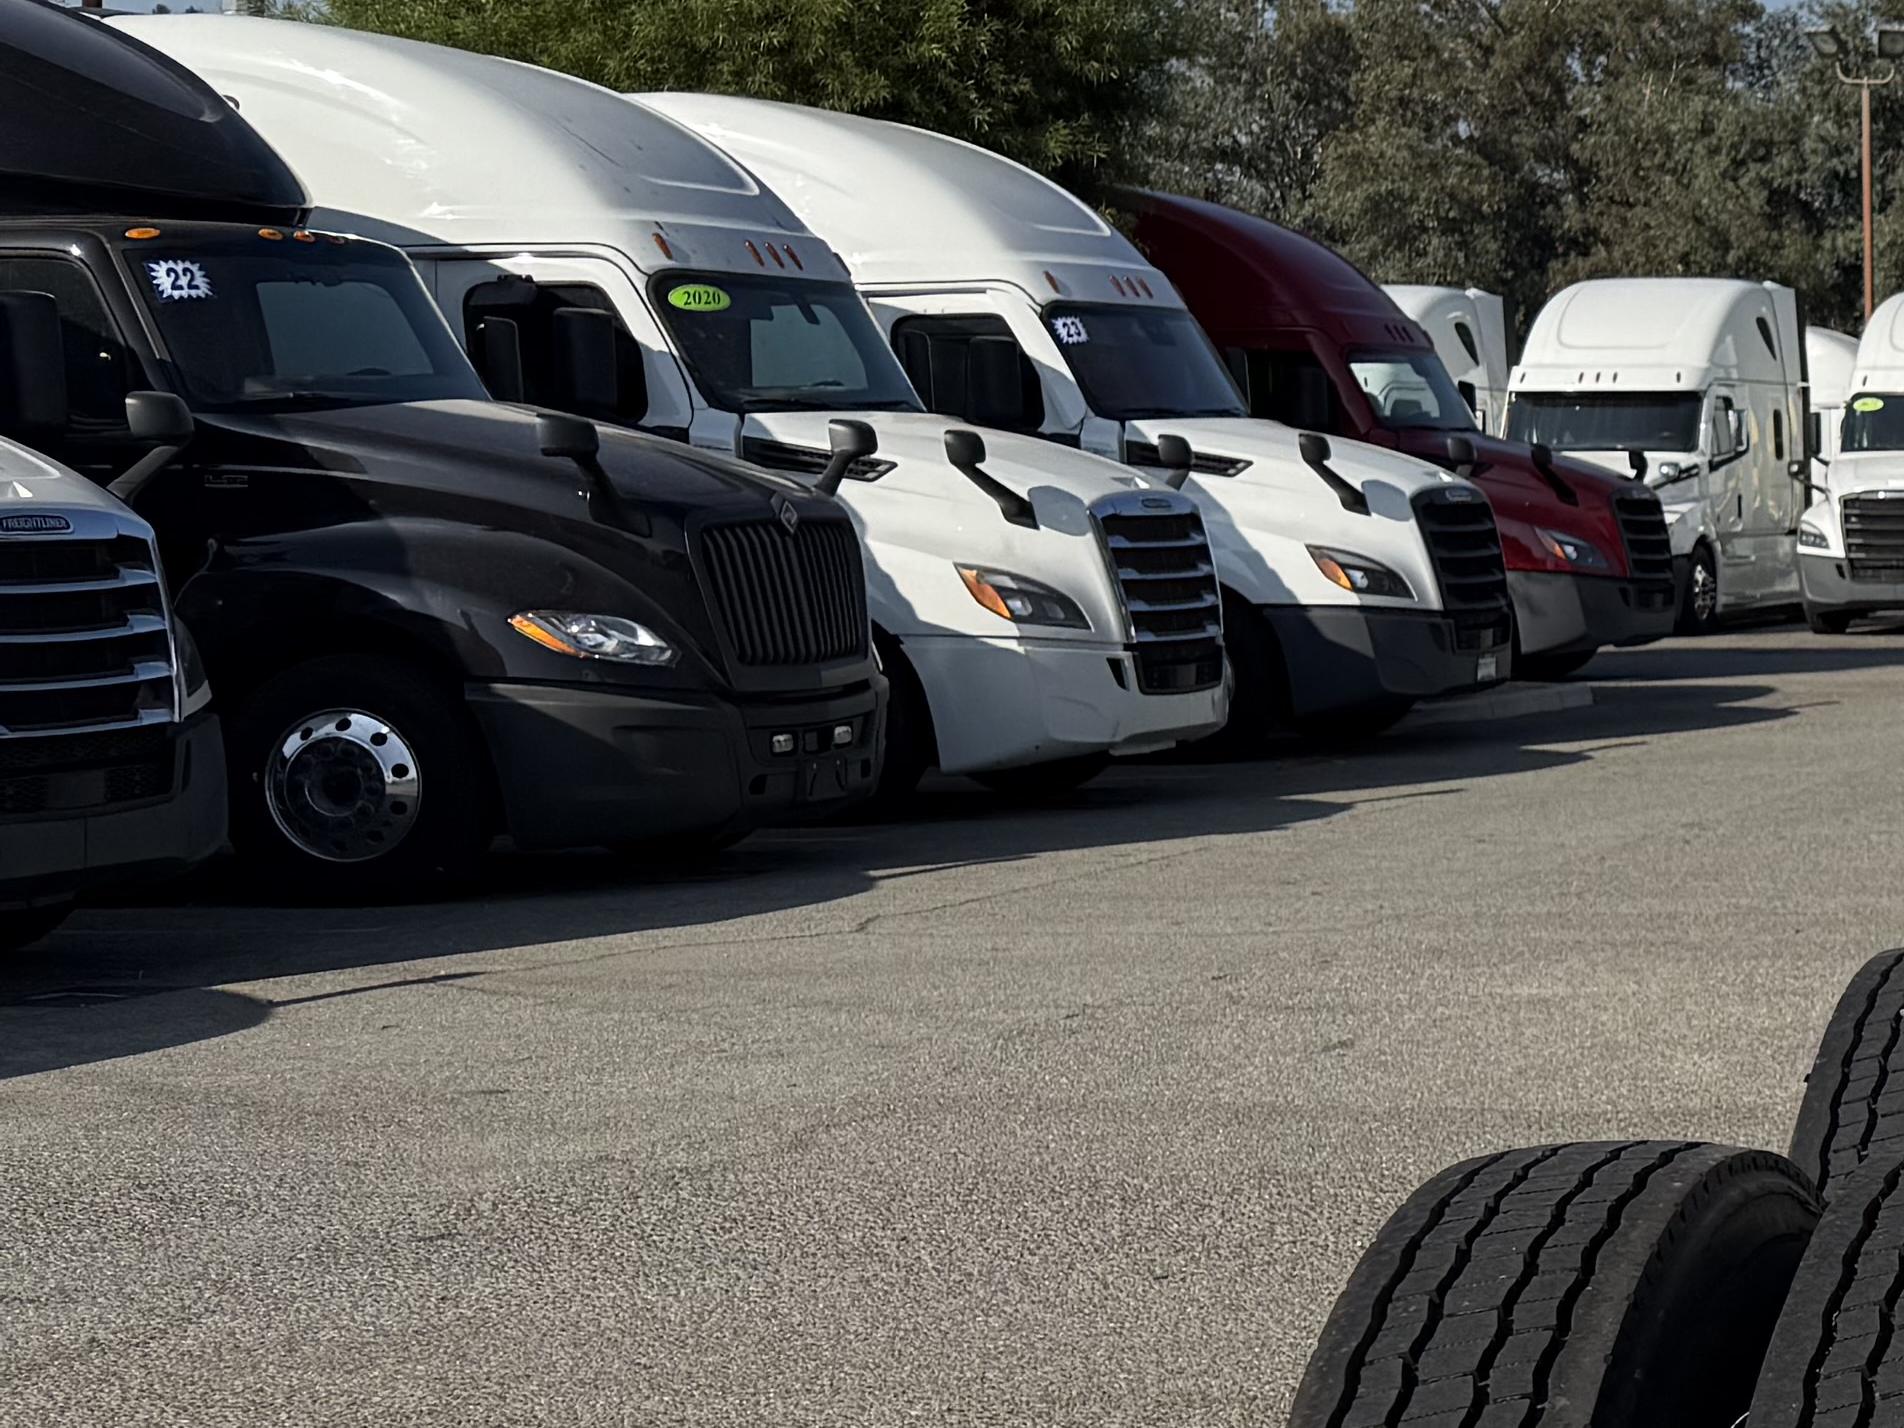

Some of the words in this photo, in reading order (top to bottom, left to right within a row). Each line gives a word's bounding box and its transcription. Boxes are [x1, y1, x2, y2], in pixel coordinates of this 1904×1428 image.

[165, 267, 201, 290] 22
[682, 290, 721, 306] 2020
[1062, 320, 1082, 338] 23
